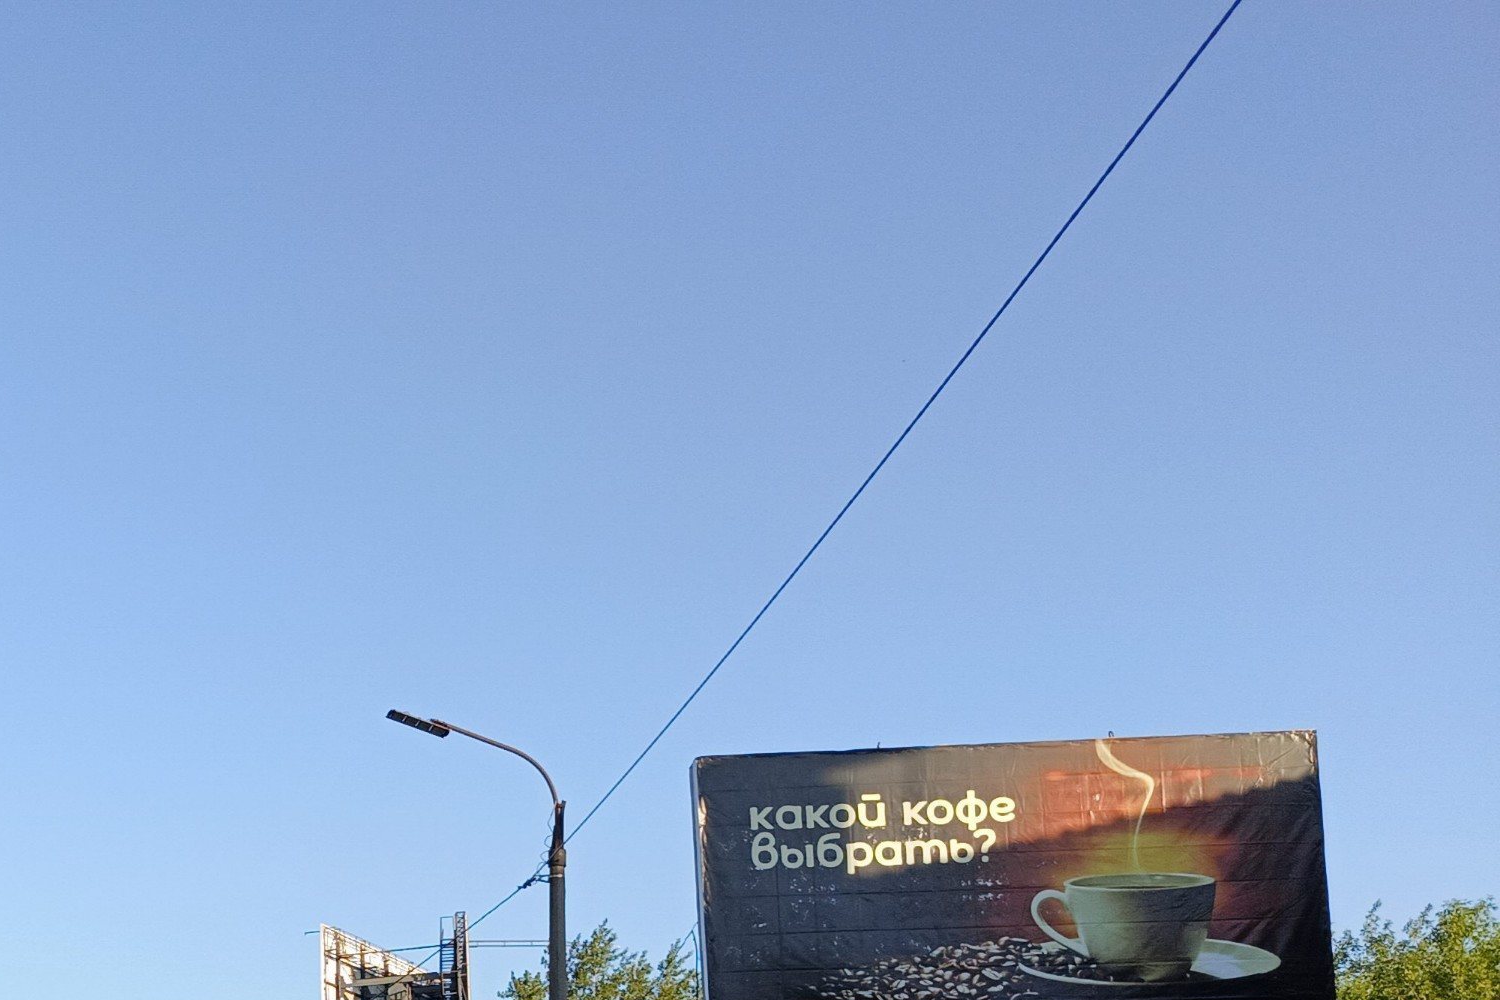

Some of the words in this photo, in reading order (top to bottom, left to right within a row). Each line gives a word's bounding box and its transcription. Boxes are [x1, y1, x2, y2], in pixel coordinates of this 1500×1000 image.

[750, 793, 886, 830] какой
[903, 790, 1016, 831] кофе
[751, 828, 997, 875] выбрать?
